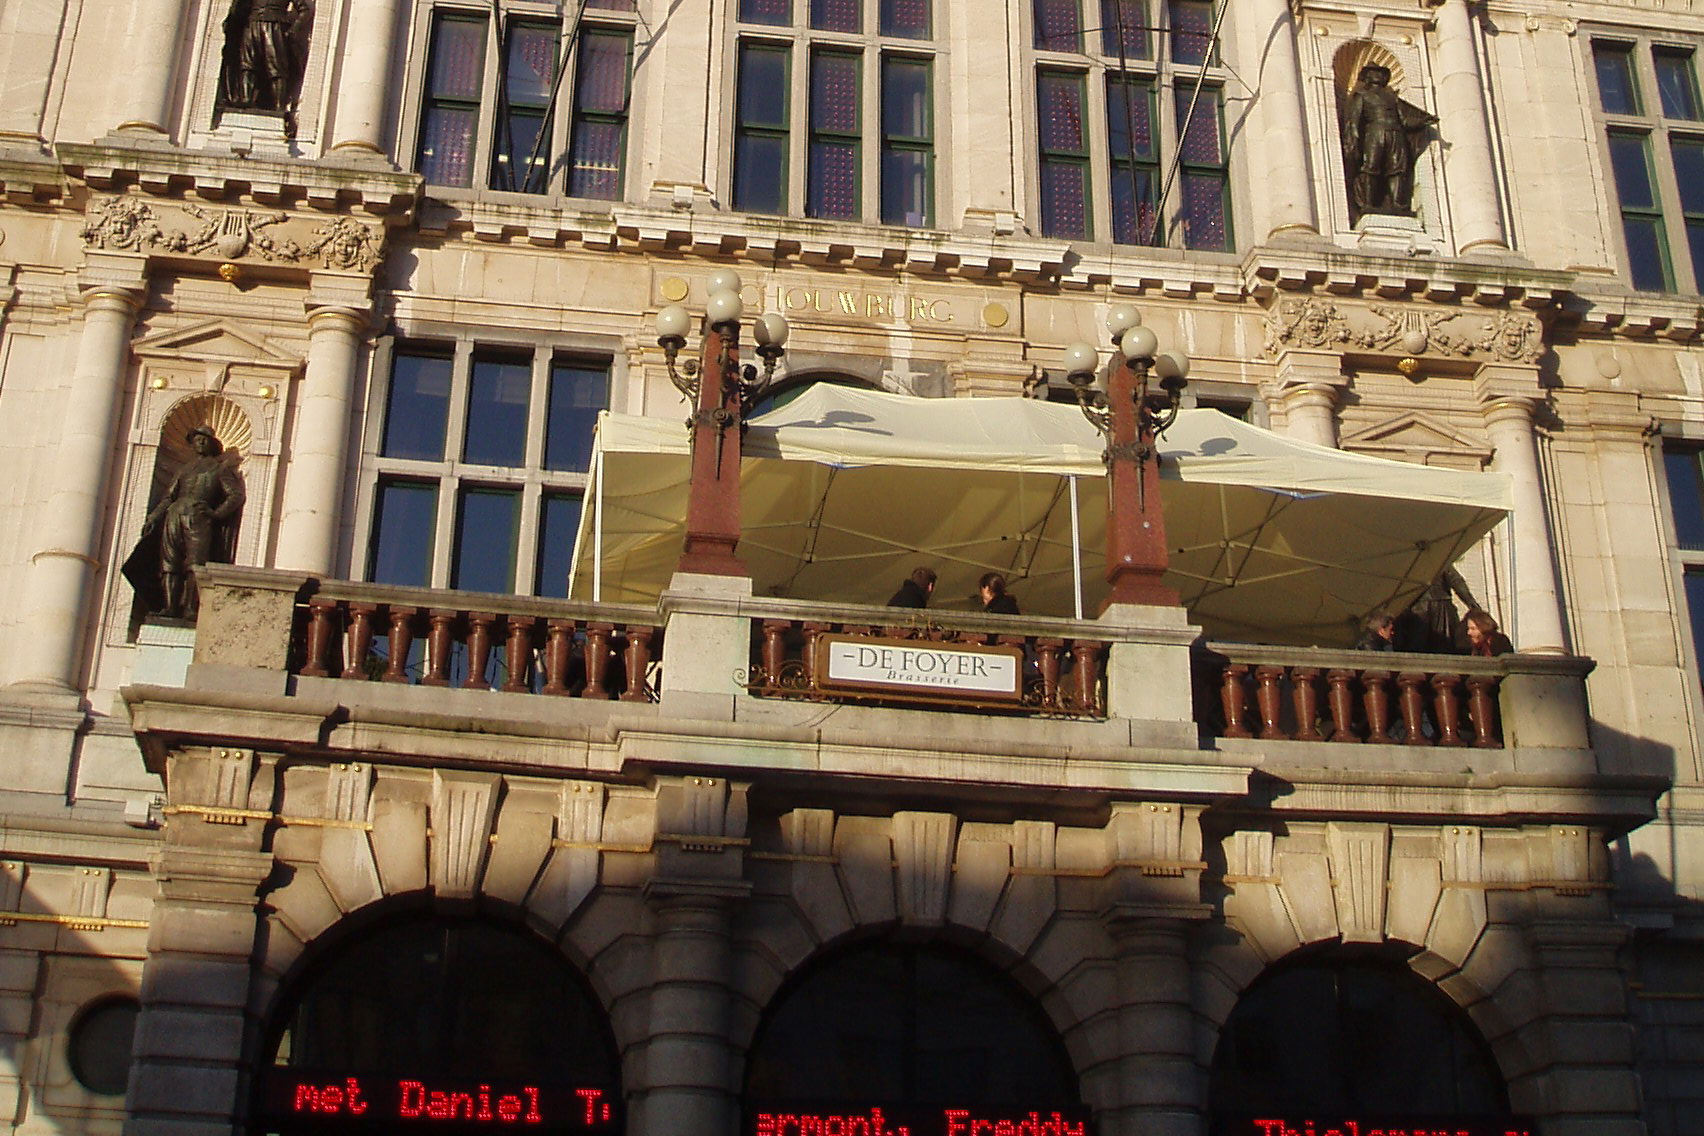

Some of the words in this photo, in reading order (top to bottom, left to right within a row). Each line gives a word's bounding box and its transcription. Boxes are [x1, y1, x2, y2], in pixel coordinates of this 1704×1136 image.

[738, 284, 955, 322] CHOUWBURG
[887, 670, 960, 685] Brasserie
[295, 1077, 368, 1115] met
[399, 1079, 543, 1124] Daniel
